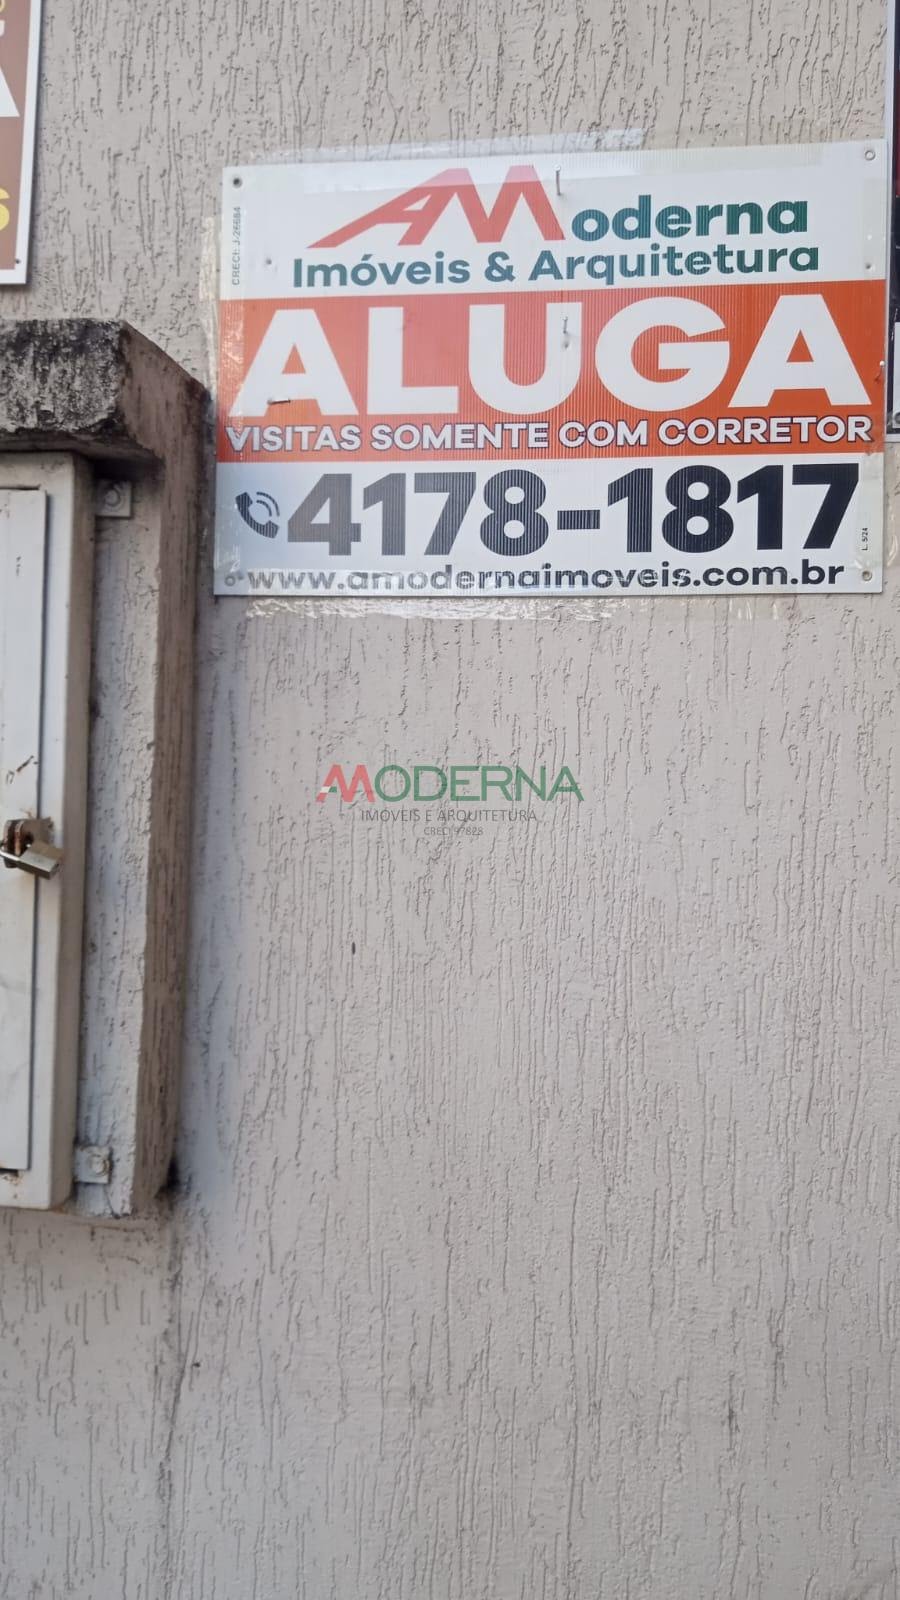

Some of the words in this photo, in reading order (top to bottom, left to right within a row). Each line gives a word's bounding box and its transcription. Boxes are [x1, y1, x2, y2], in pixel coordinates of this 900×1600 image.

[293, 251, 471, 288] Imóveis
[486, 251, 516, 283] &
[528, 242, 820, 285] Arquitetura
[229, 293, 872, 418] ALUGA
[225, 425, 362, 453] VISITAS
[370, 420, 549, 451] SOMENTE
[558, 418, 649, 447] COM
[657, 414, 873, 448] CORRETOR
[287, 463, 860, 557] 4178-1817
[247, 558, 845, 590] www.amodernaimoveis.com.br
